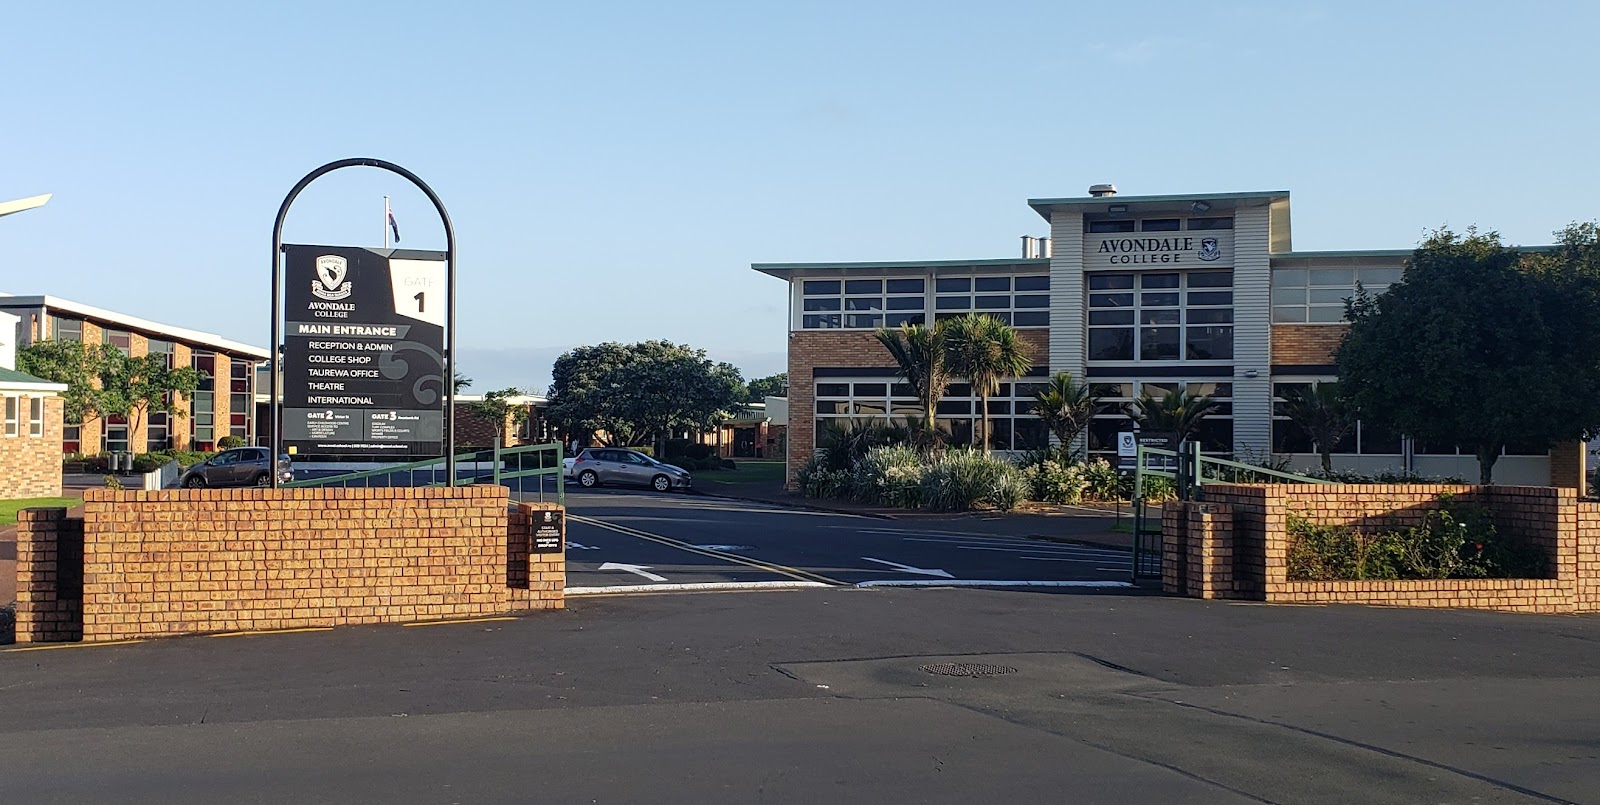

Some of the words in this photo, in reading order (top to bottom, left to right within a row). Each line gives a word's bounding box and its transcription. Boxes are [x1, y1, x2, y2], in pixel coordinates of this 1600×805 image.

[1098, 238, 1193, 253] AVONDALE
[1110, 254, 1180, 264] COLLEGE
[308, 302, 355, 311] AVONDALE
[413, 292, 424, 313] 1
[299, 325, 330, 334] MAIN
[333, 326, 396, 336] ENTRANCE
[309, 342, 355, 350] RECEPTION
[365, 343, 392, 351] ADMIN
[308, 355, 346, 364] COLLEGE
[348, 356, 371, 364] SHOP
[308, 369, 349, 377] TAUREWA
[351, 370, 379, 378] OFFICE
[308, 382, 344, 391] THEATRE
[308, 396, 374, 405] INTERNATIONAL
[326, 410, 333, 419] 2
[389, 411, 397, 420] 3
